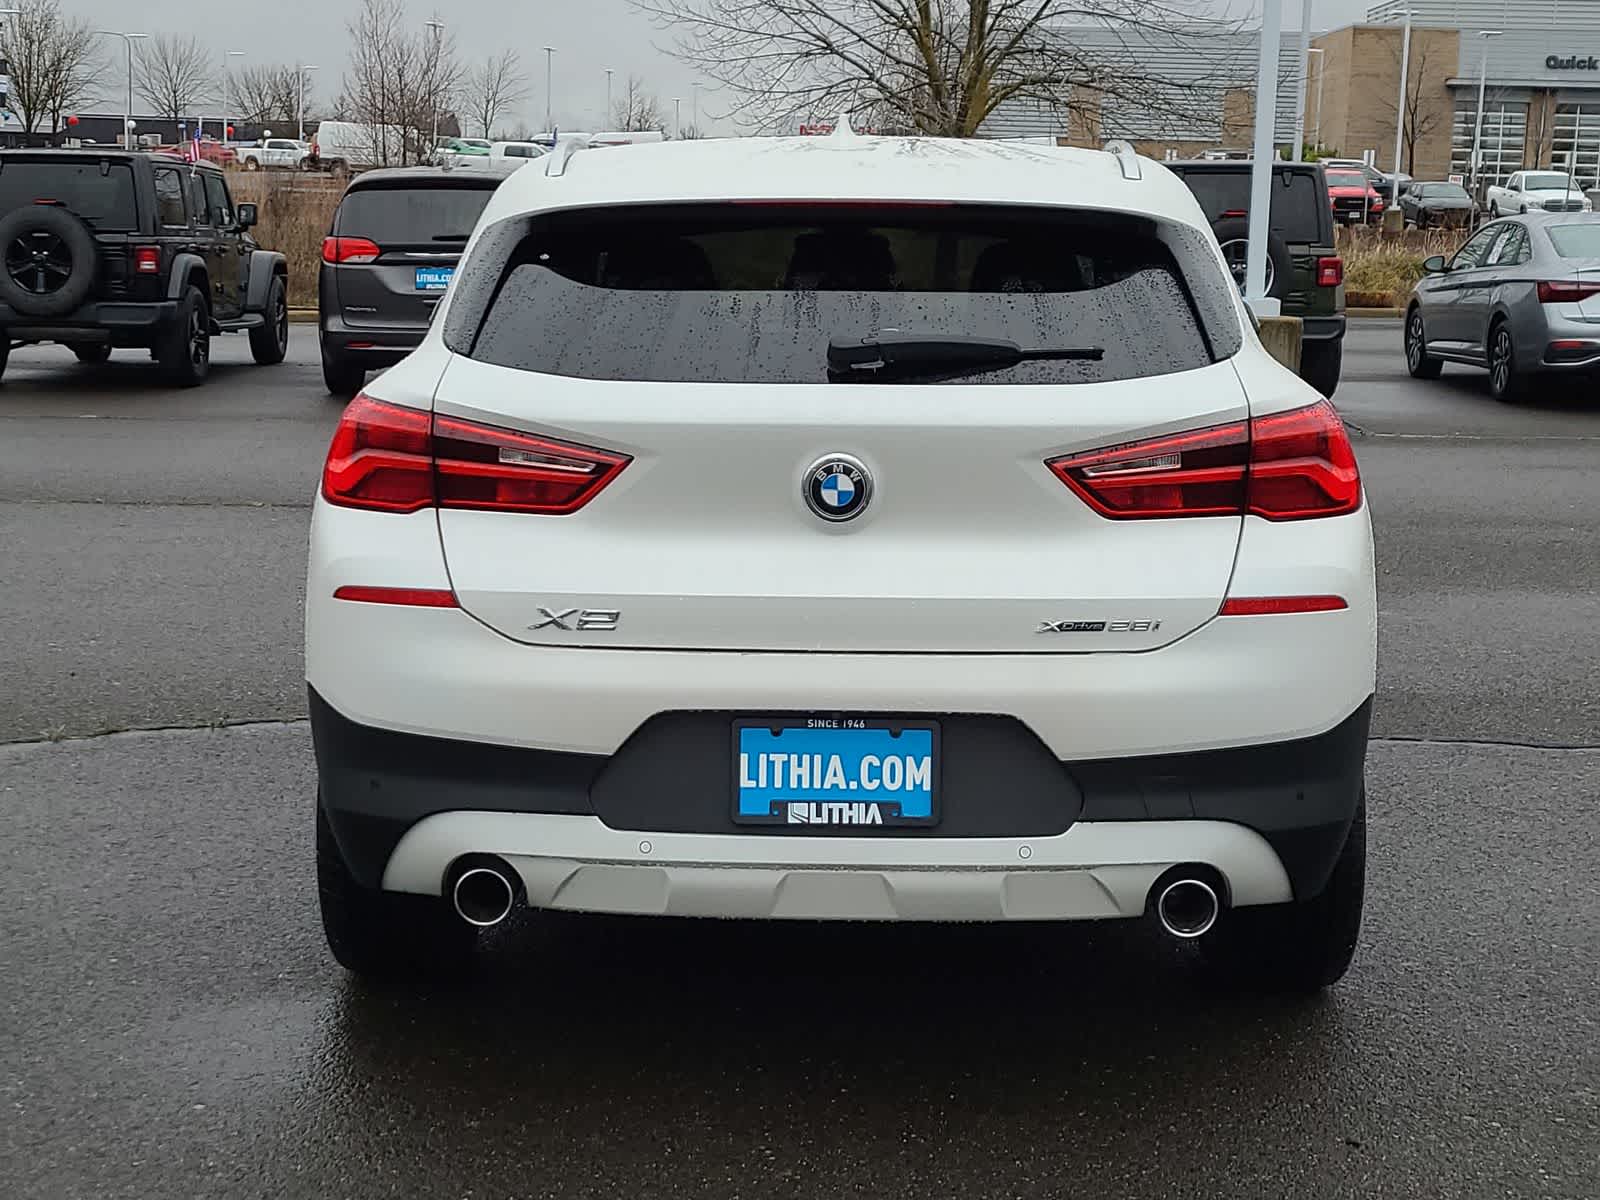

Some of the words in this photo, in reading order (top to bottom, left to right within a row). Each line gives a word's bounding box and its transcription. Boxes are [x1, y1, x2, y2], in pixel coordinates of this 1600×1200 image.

[1545, 55, 1599, 70] Quick
[416, 273, 453, 282] LITHIA.CO
[816, 464, 861, 482] BMW
[527, 607, 620, 631] X2
[807, 719, 839, 728] SINCE
[843, 719, 865, 729] 1946
[739, 752, 932, 791] LITHIA.COM
[809, 802, 883, 825] LITHIA
